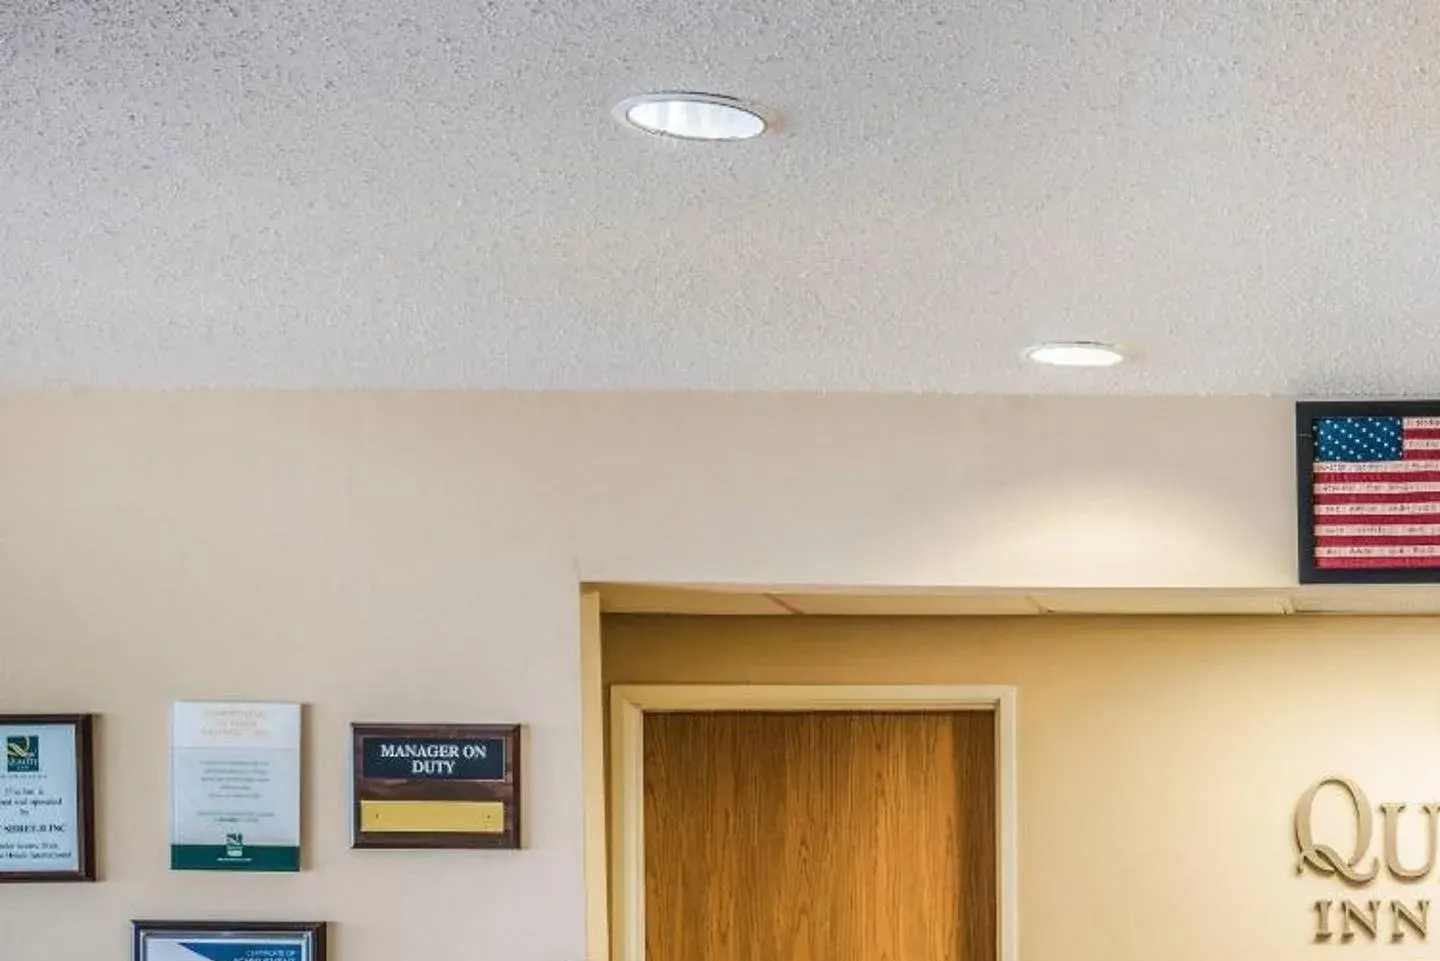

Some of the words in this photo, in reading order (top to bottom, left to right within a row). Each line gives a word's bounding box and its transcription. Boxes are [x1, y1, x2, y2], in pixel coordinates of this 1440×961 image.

[380, 744, 459, 758] MANAGER
[463, 744, 486, 758] ON
[411, 760, 455, 773] DUTY
[1313, 898, 1430, 942] INN
